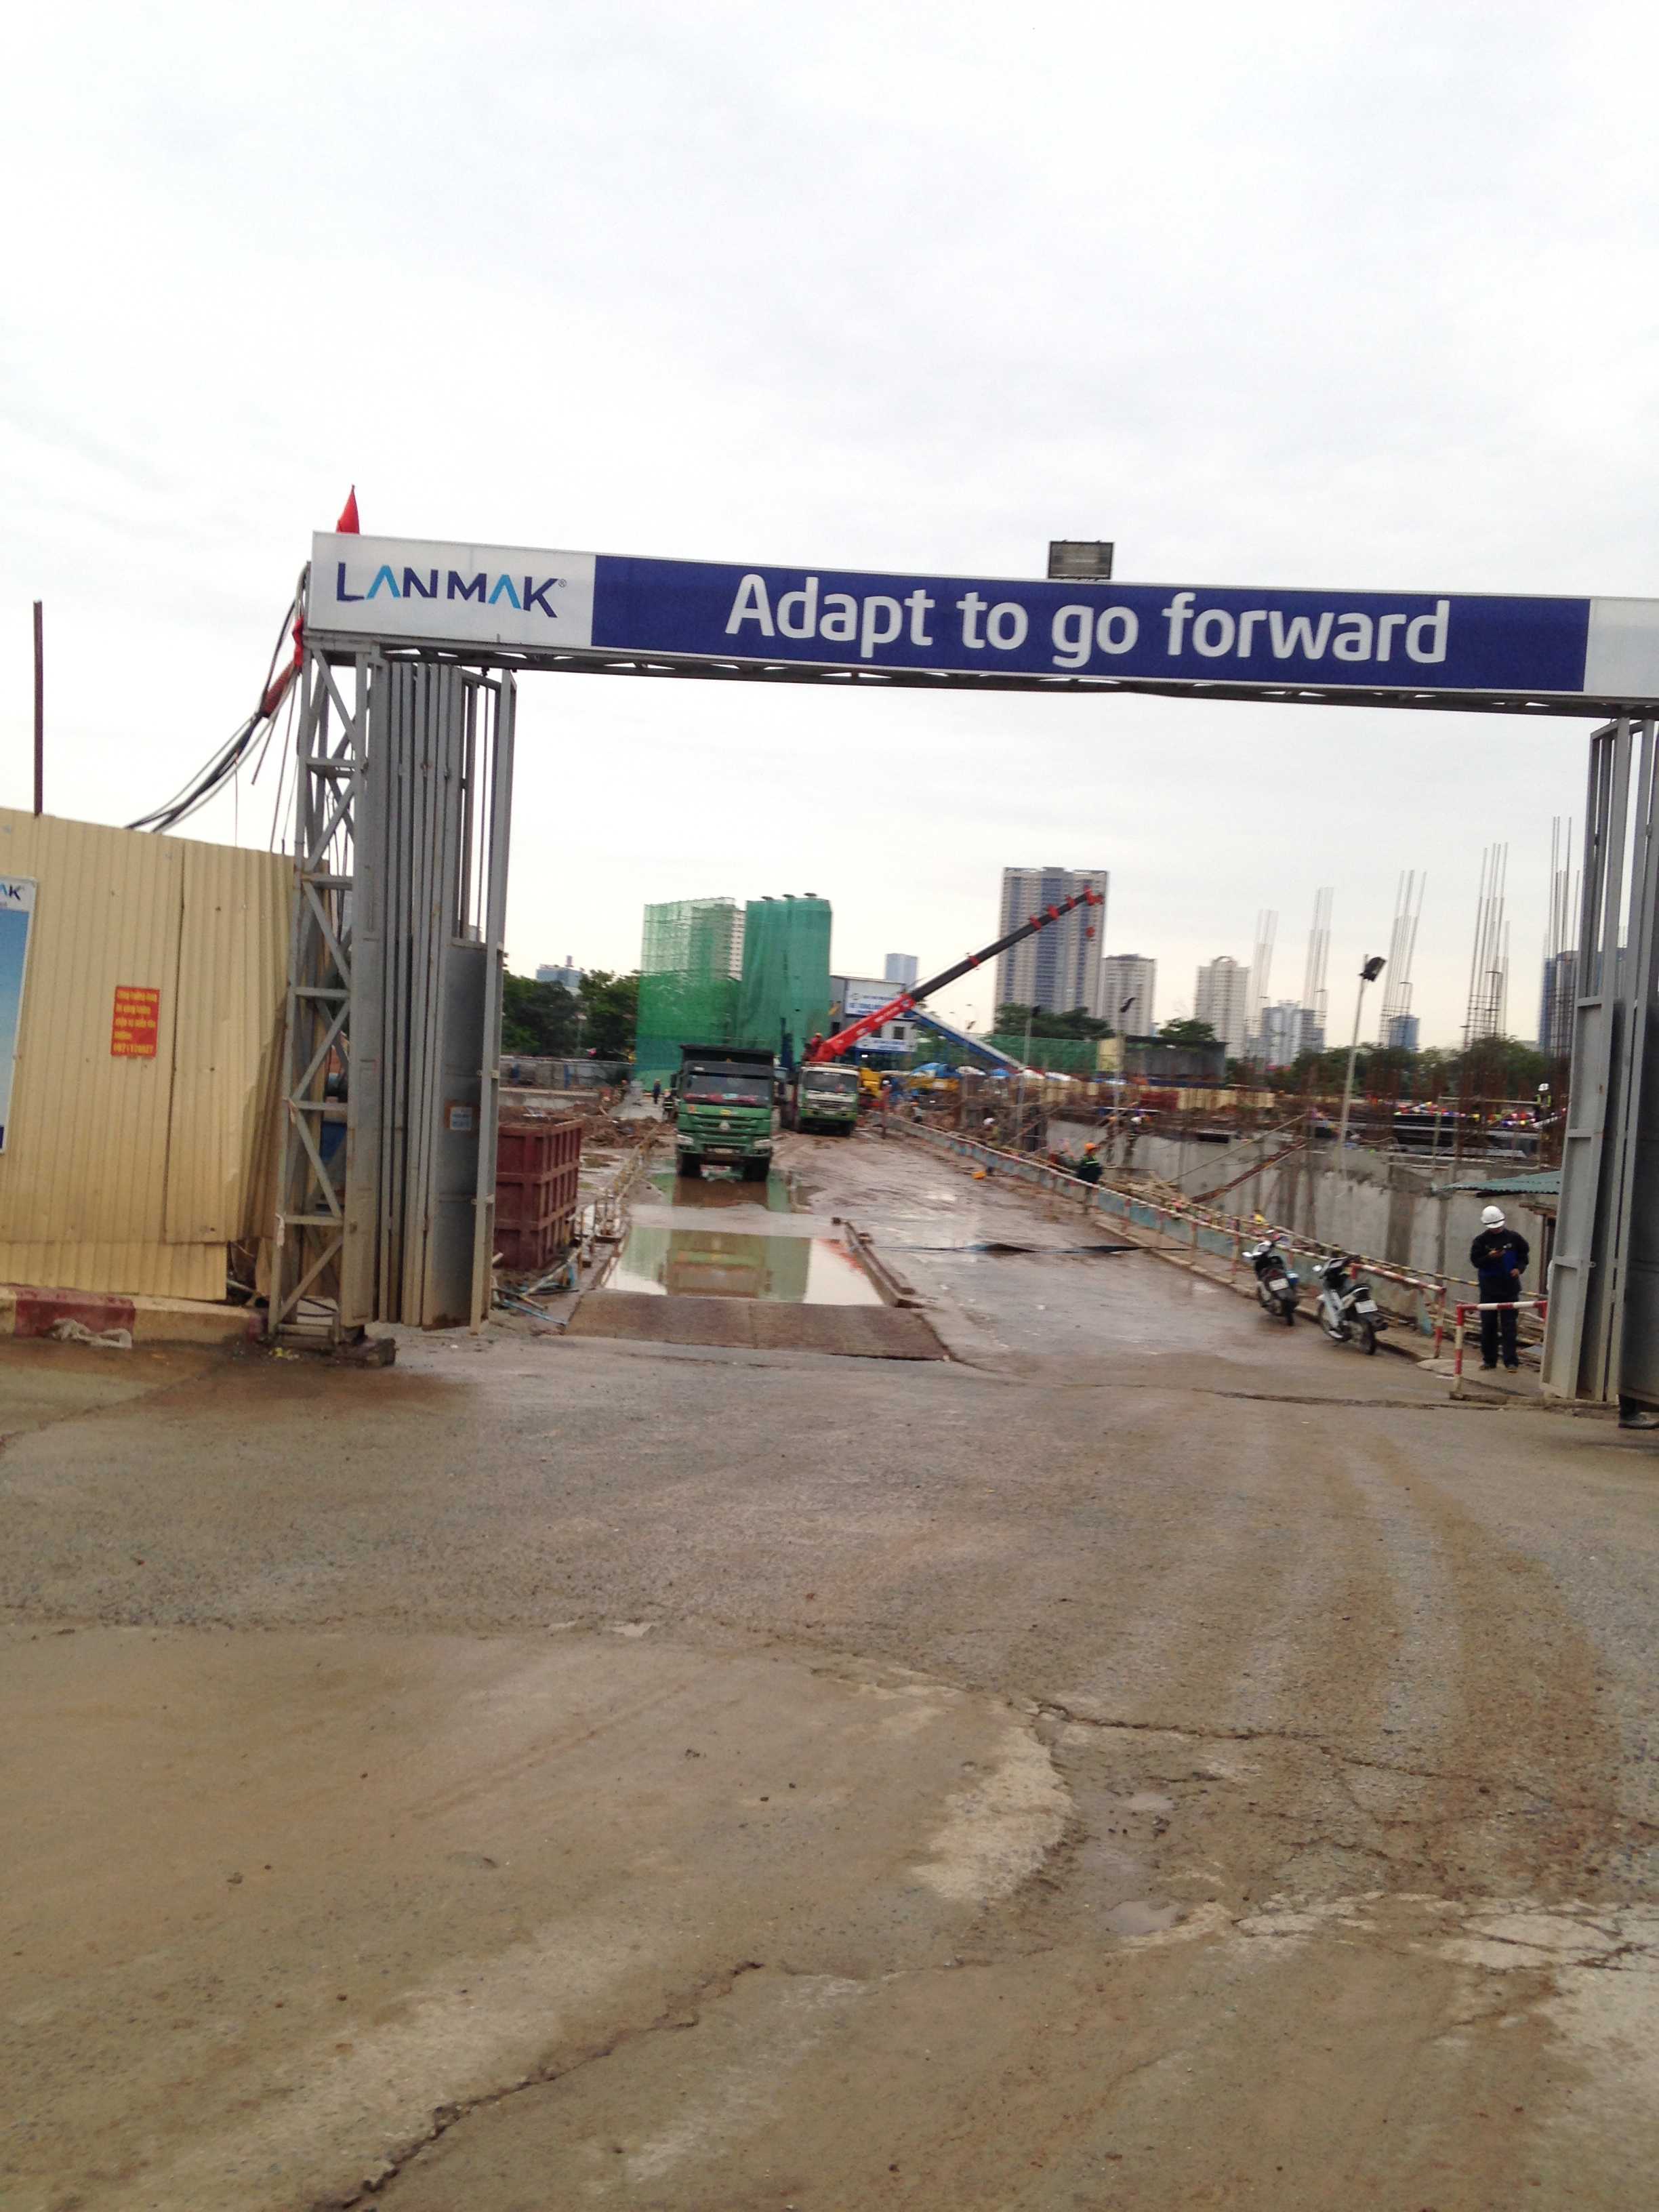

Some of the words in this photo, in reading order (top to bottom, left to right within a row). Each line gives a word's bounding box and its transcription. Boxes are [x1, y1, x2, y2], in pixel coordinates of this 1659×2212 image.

[336, 561, 558, 618] LANMAK
[724, 573, 935, 659] Adapt
[956, 591, 1029, 650] to
[1051, 603, 1139, 668] go
[1162, 591, 1451, 663] forward
